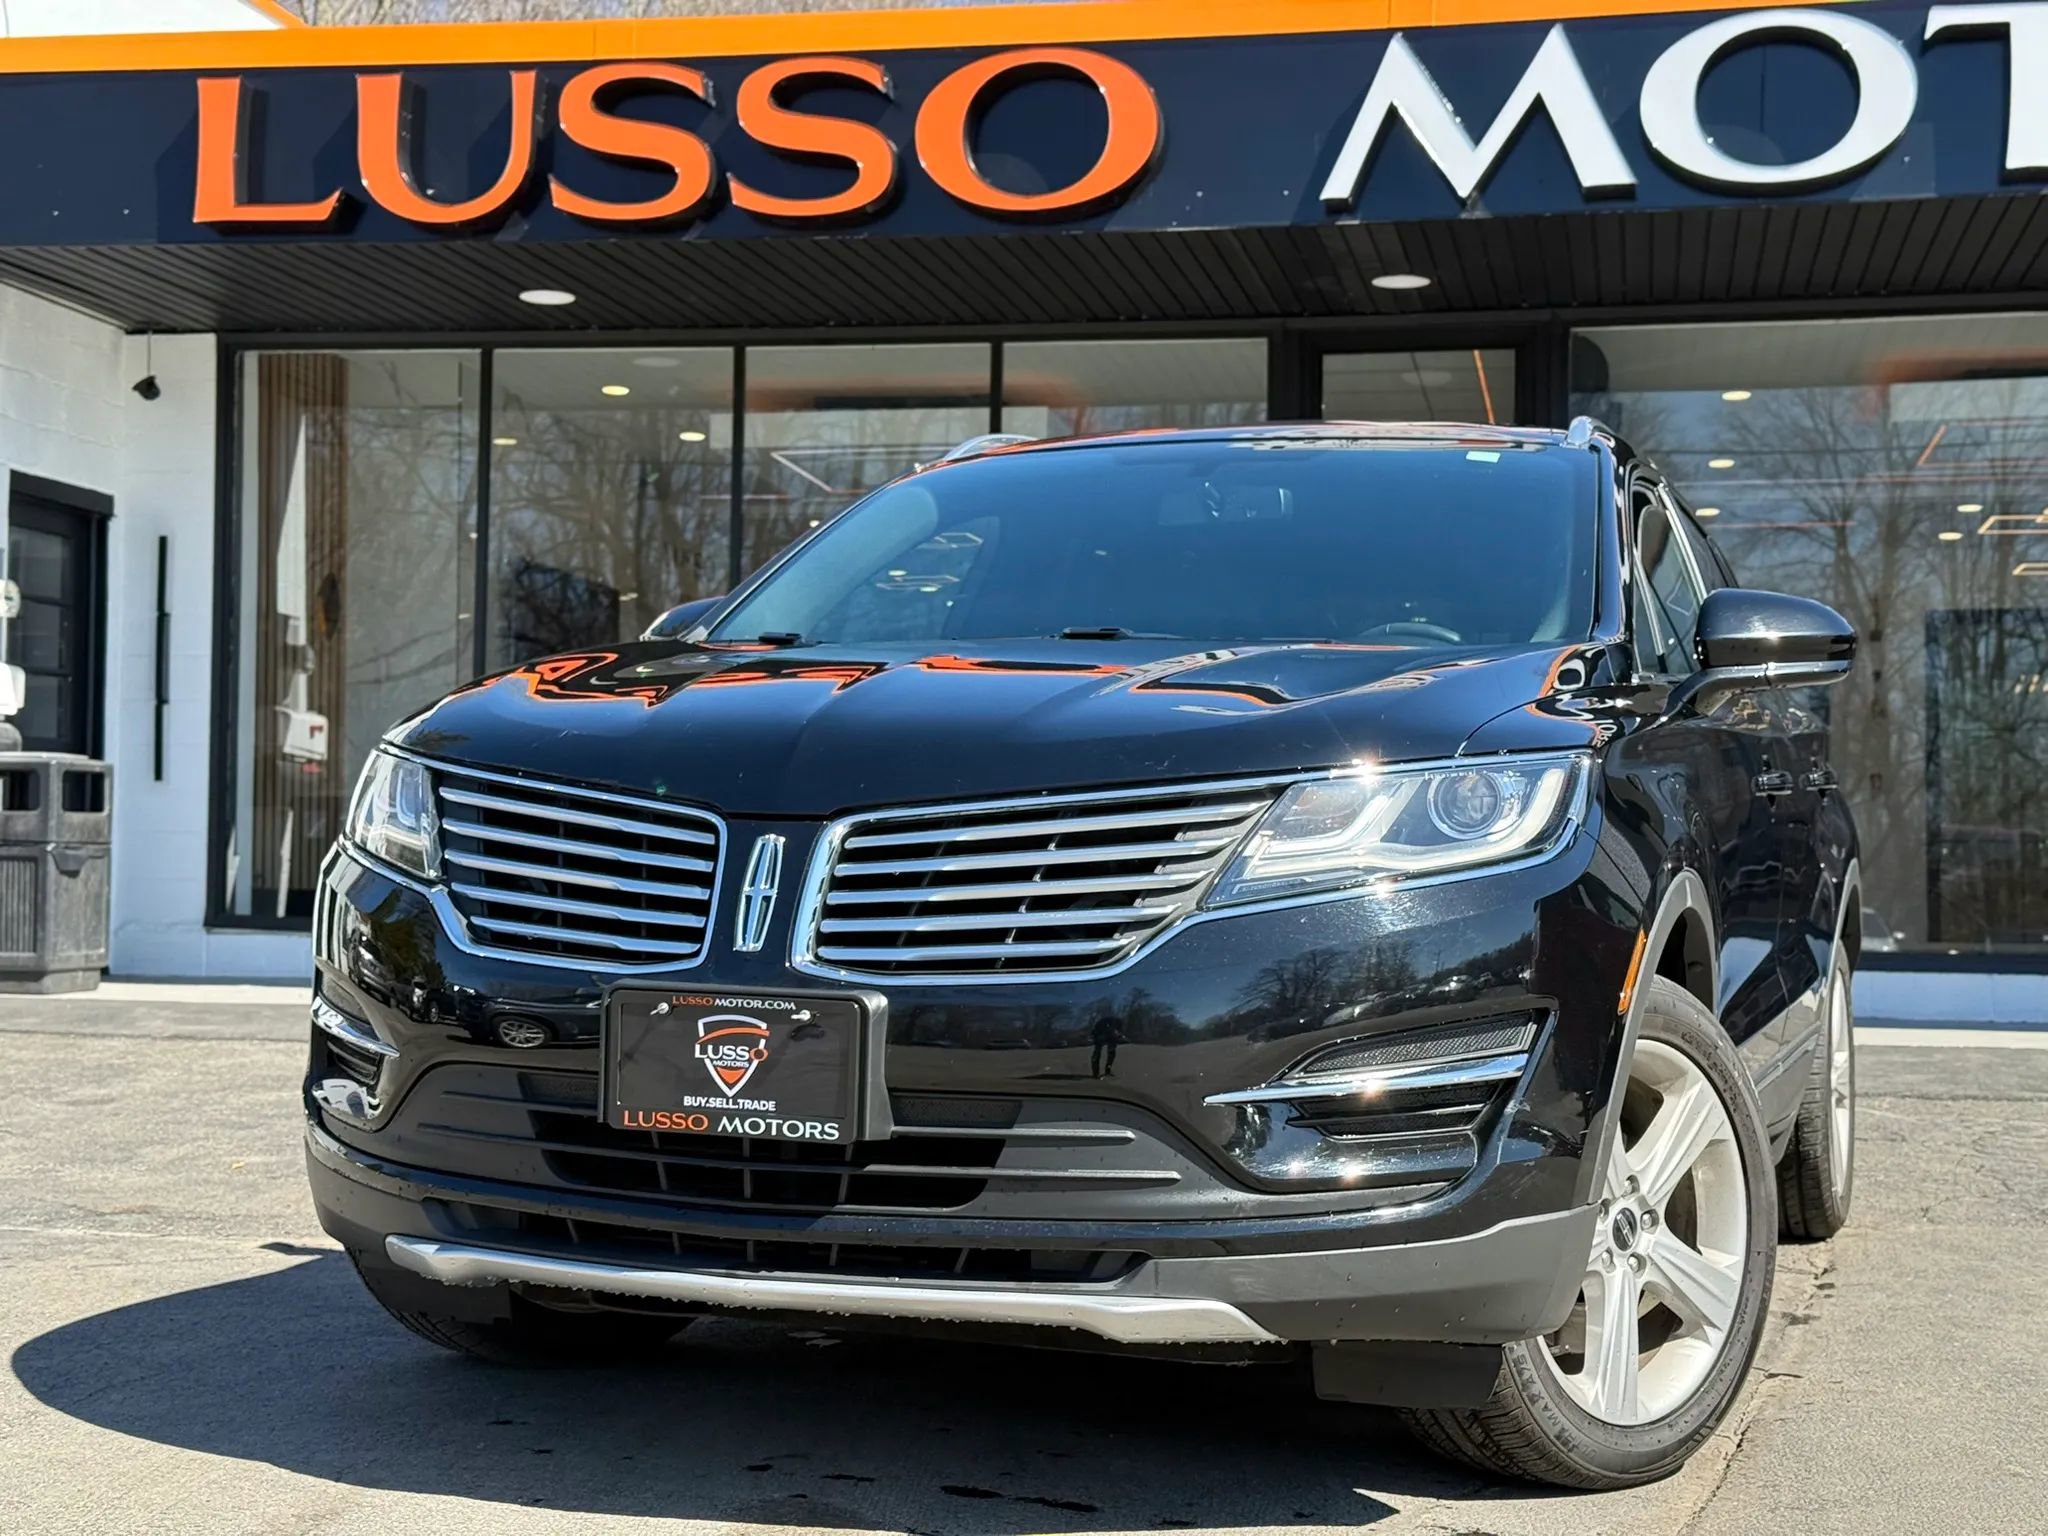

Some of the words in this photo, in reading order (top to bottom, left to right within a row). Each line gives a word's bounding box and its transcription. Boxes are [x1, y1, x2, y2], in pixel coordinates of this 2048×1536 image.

[193, 47, 1160, 224] LUSSO
[695, 1044, 768, 1062] LUSSO
[713, 1060, 749, 1068] MOTORS
[623, 1110, 709, 1131] LUSSO
[717, 1116, 839, 1140] MOTORS
